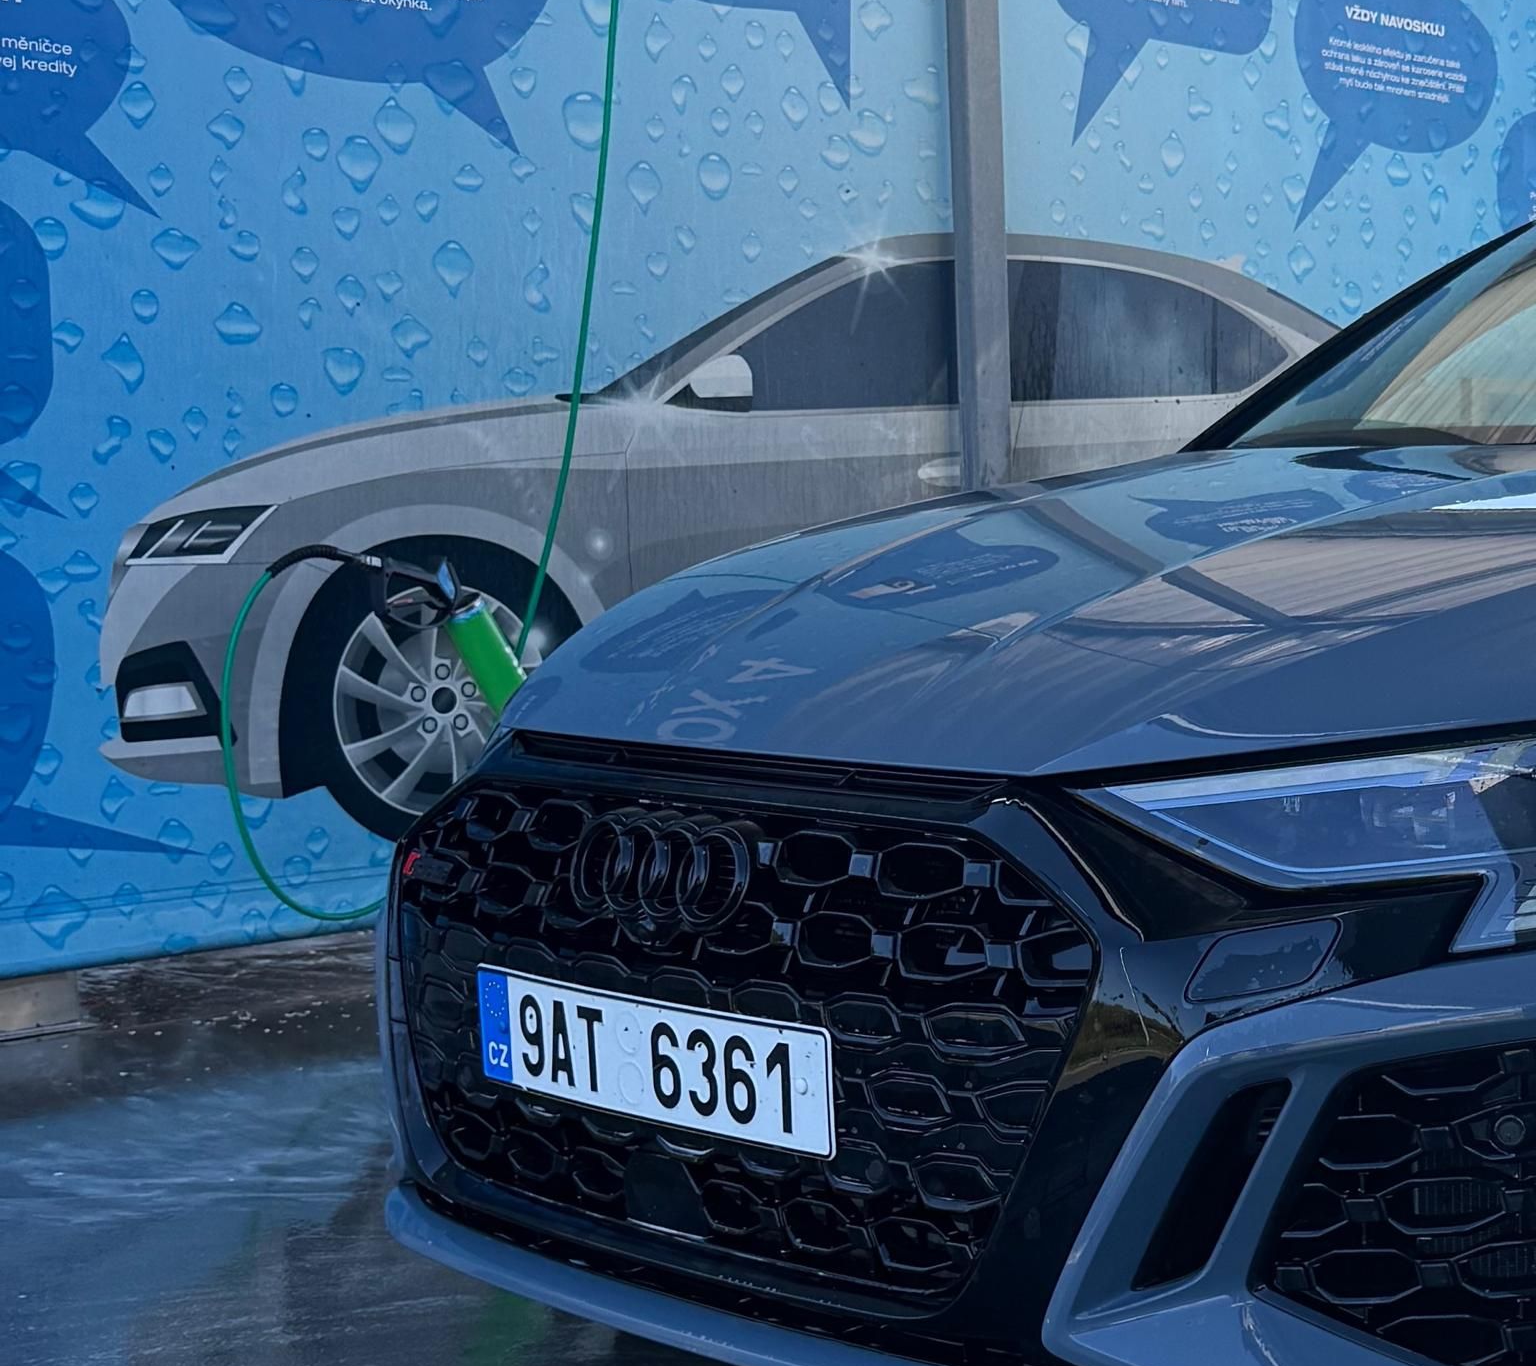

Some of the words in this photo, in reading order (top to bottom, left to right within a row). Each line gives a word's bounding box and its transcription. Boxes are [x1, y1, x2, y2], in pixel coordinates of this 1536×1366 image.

[1345, 4, 1378, 24] VŽDY
[1381, 14, 1445, 37] NAVOSKUJ
[21, 55, 78, 77] kredity
[488, 1041, 509, 1068] CZ
[519, 993, 603, 1092] 9AT
[650, 1021, 793, 1134] 6361
